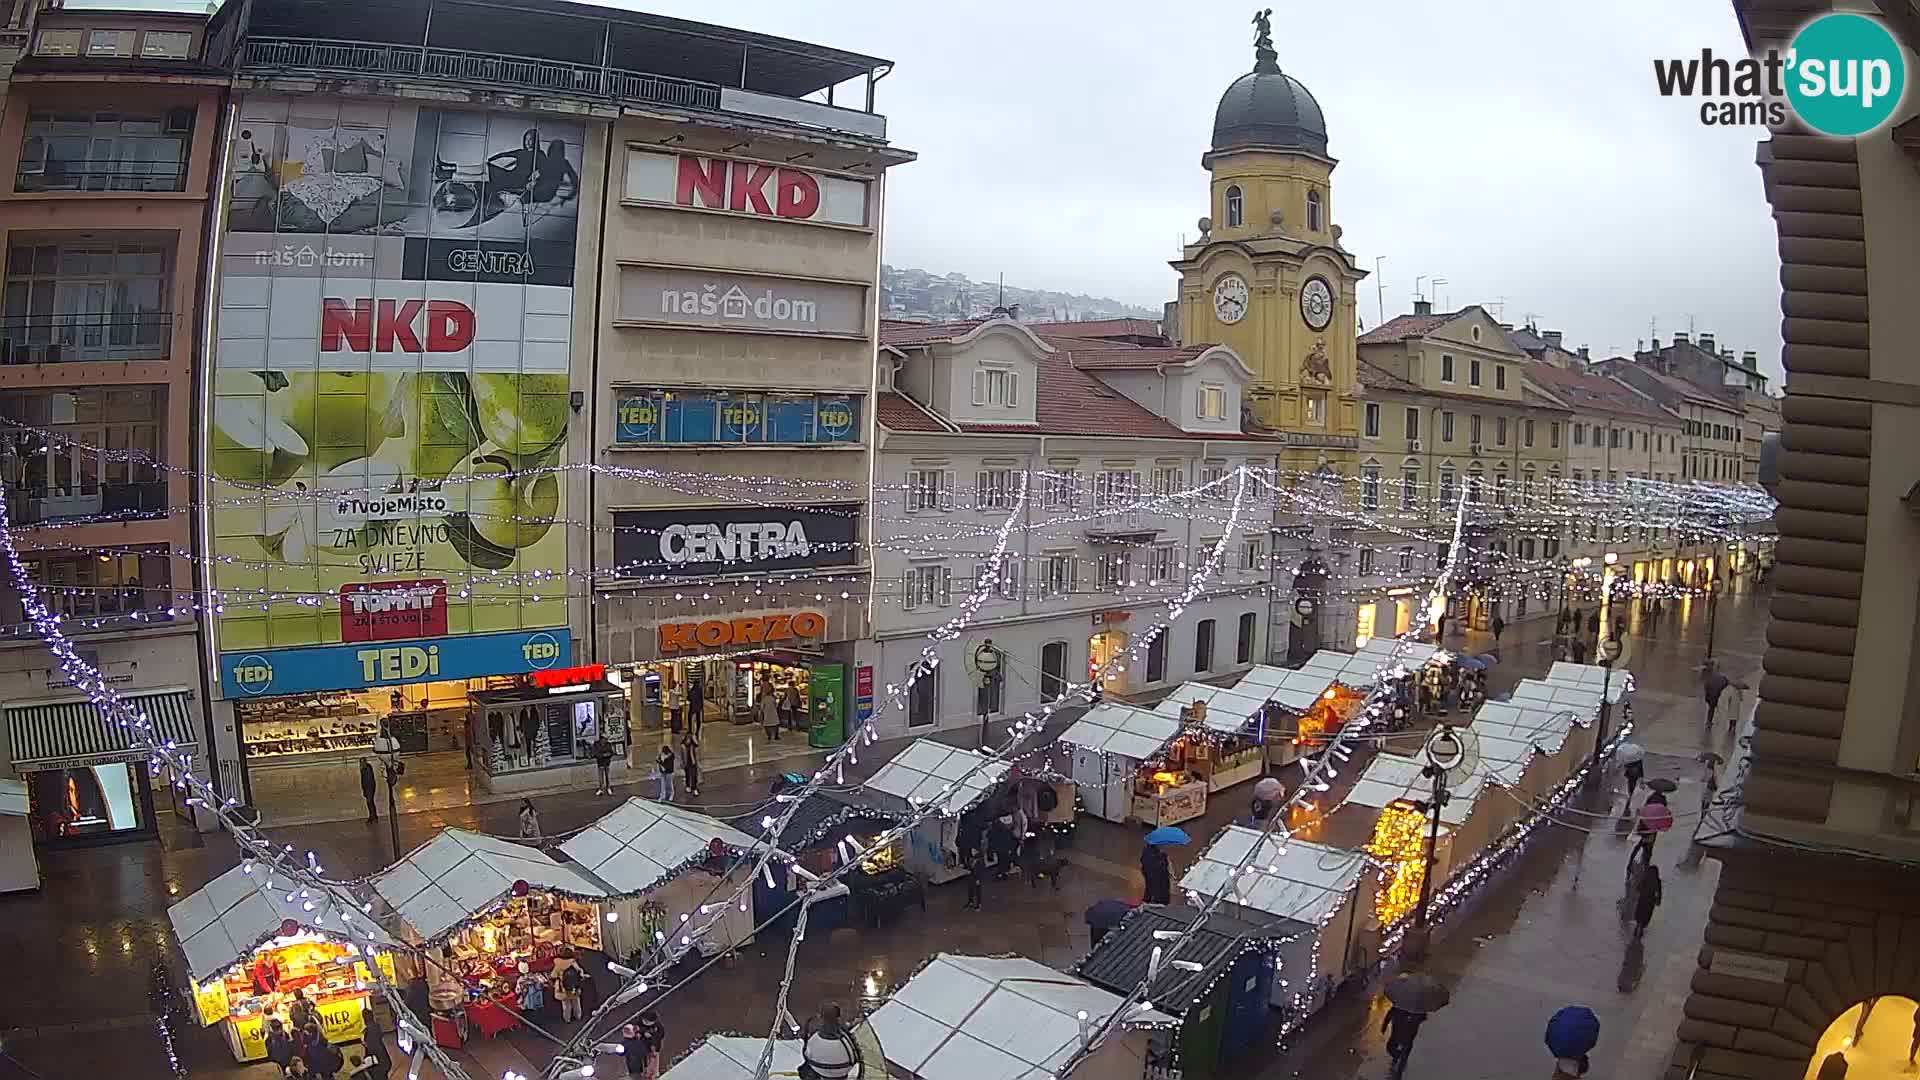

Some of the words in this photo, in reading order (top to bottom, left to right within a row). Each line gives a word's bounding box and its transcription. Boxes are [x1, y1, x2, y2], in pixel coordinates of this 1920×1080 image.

[675, 153, 821, 219] NKD
[320, 246, 366, 267] dom
[448, 249, 534, 275] CENTRA
[661, 284, 717, 316] naš
[755, 289, 817, 323] dom
[320, 297, 477, 353] NKD
[619, 407, 657, 425] TEDi
[723, 408, 759, 425] TEDi
[337, 496, 446, 516] #TvojeMisto
[333, 528, 358, 549] ZA
[365, 523, 450, 548] DNEVNO
[659, 520, 810, 563] CENTRA
[659, 612, 826, 652] KORZO
[358, 645, 439, 682] TEDi
[522, 642, 559, 660] TEDi
[233, 665, 273, 683] TEDi
